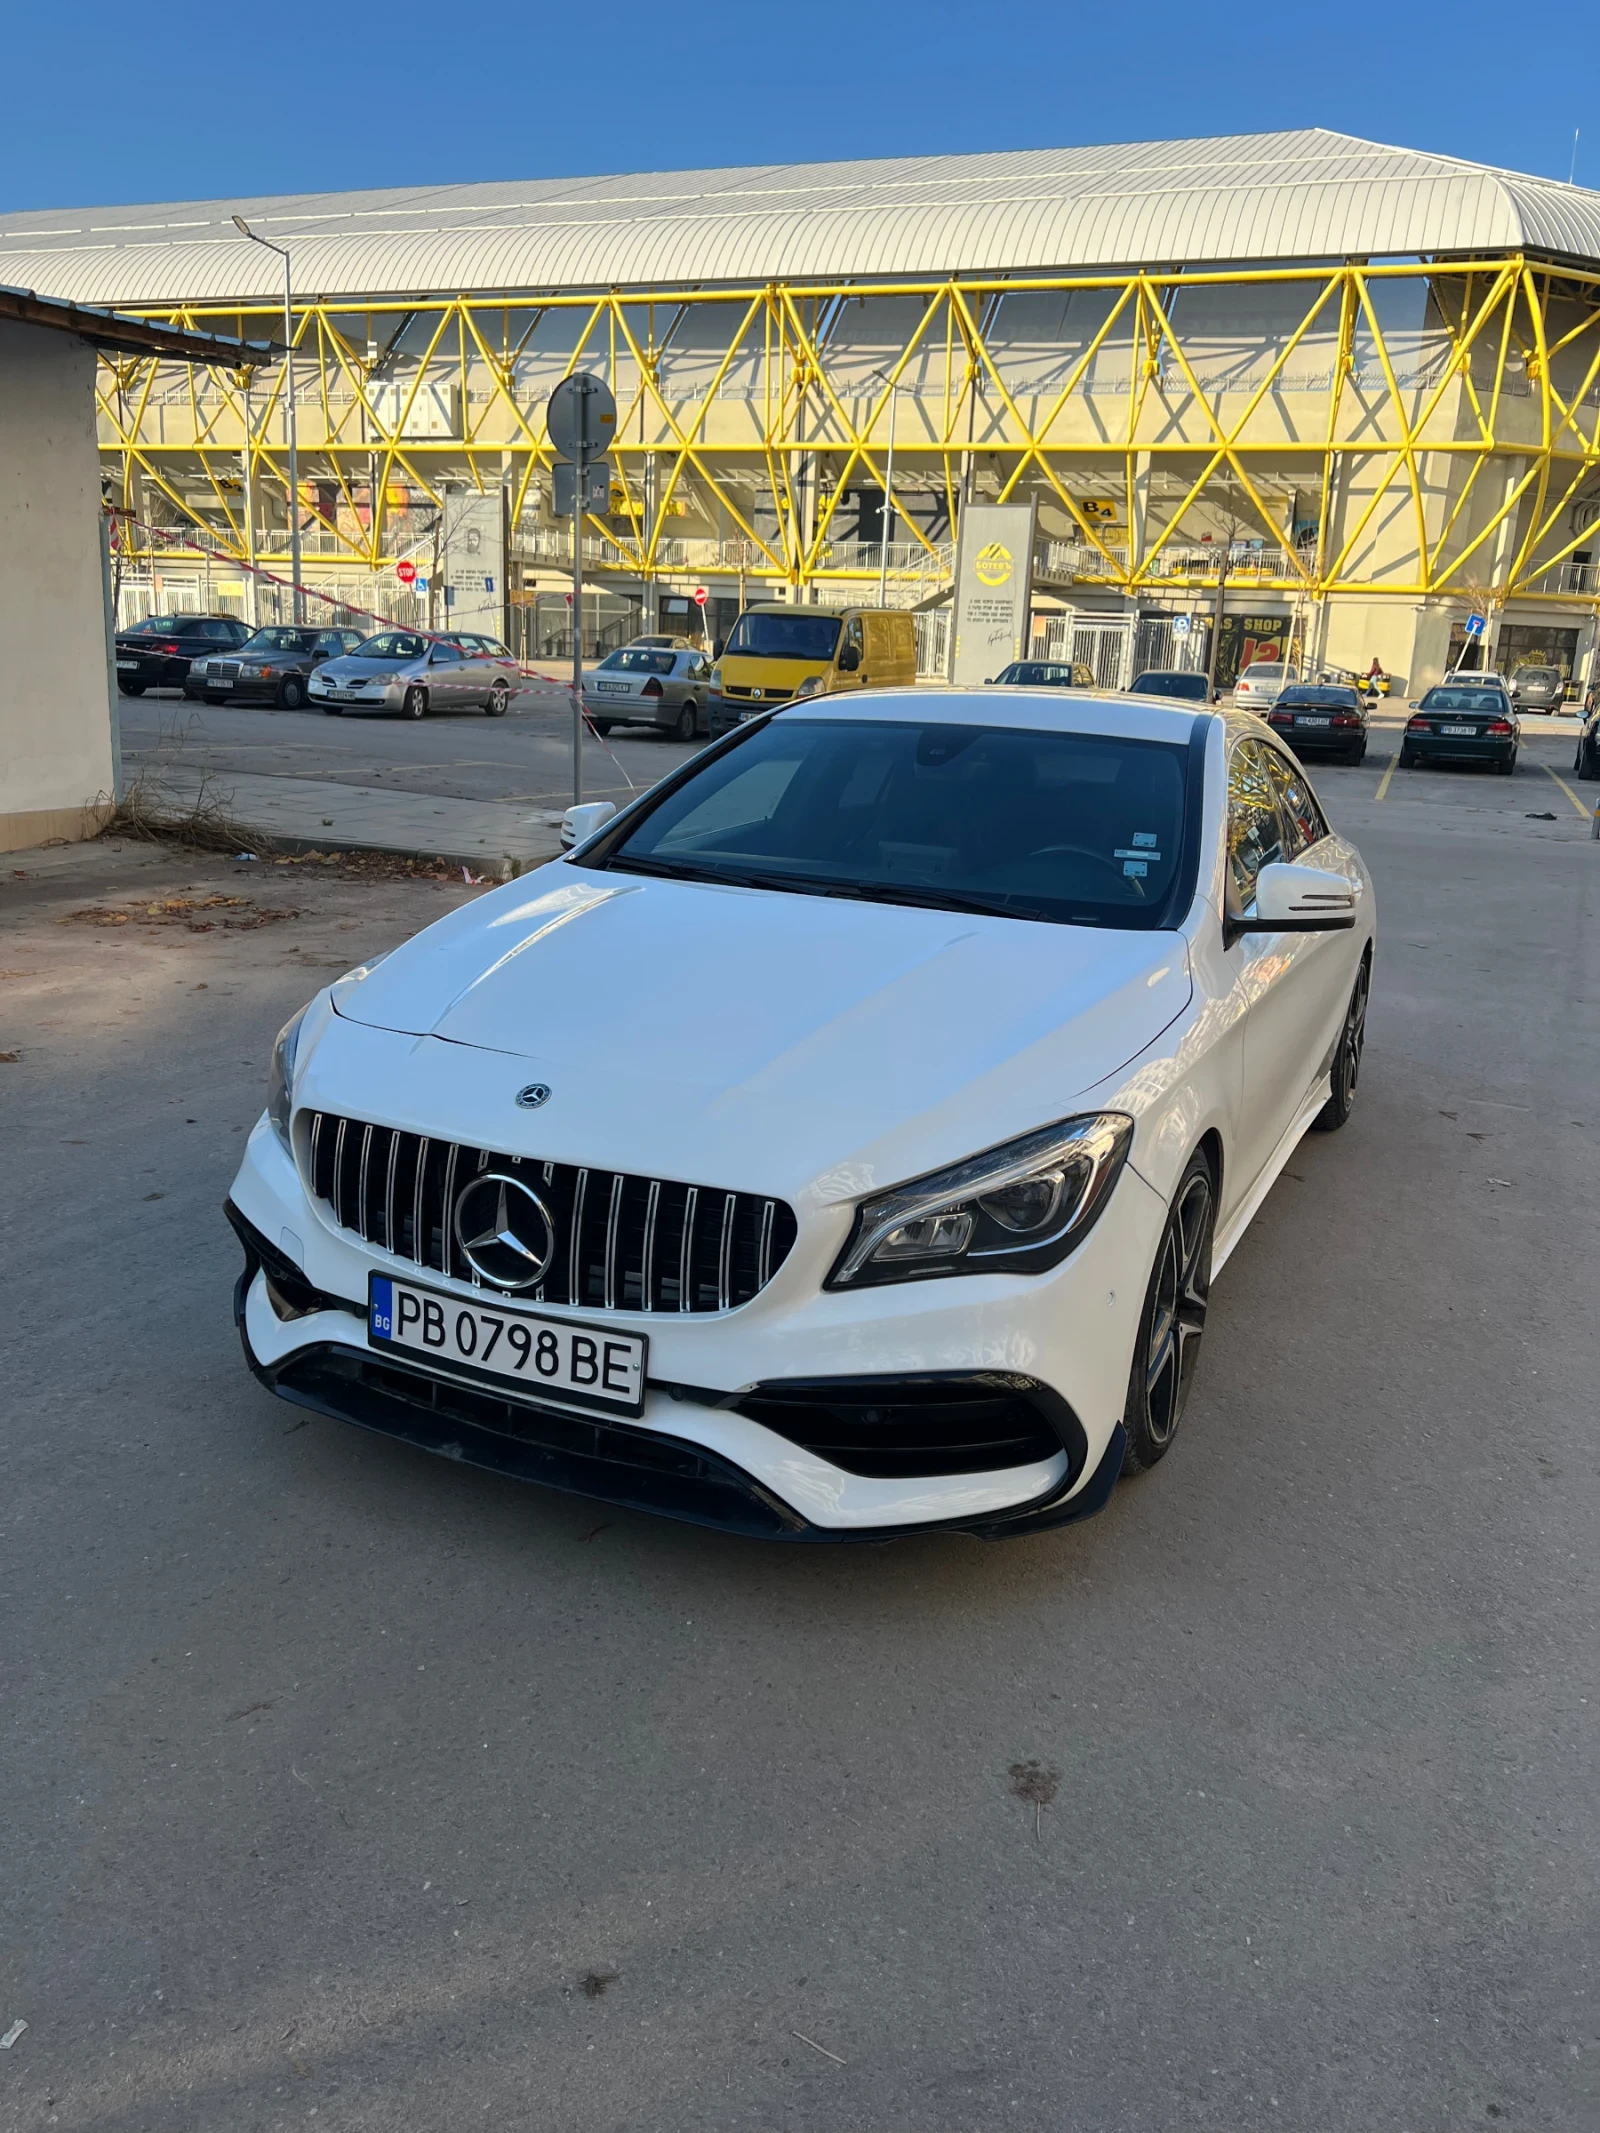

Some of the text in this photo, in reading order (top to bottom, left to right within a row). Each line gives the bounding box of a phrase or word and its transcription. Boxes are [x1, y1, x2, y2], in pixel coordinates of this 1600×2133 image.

[975, 561, 1012, 570] БОТЕВЪ
[398, 568, 414, 578] STOP
[1243, 618, 1282, 632] SHOP
[375, 1314, 391, 1331] BG
[397, 1290, 632, 1395] PB 0798 BE
